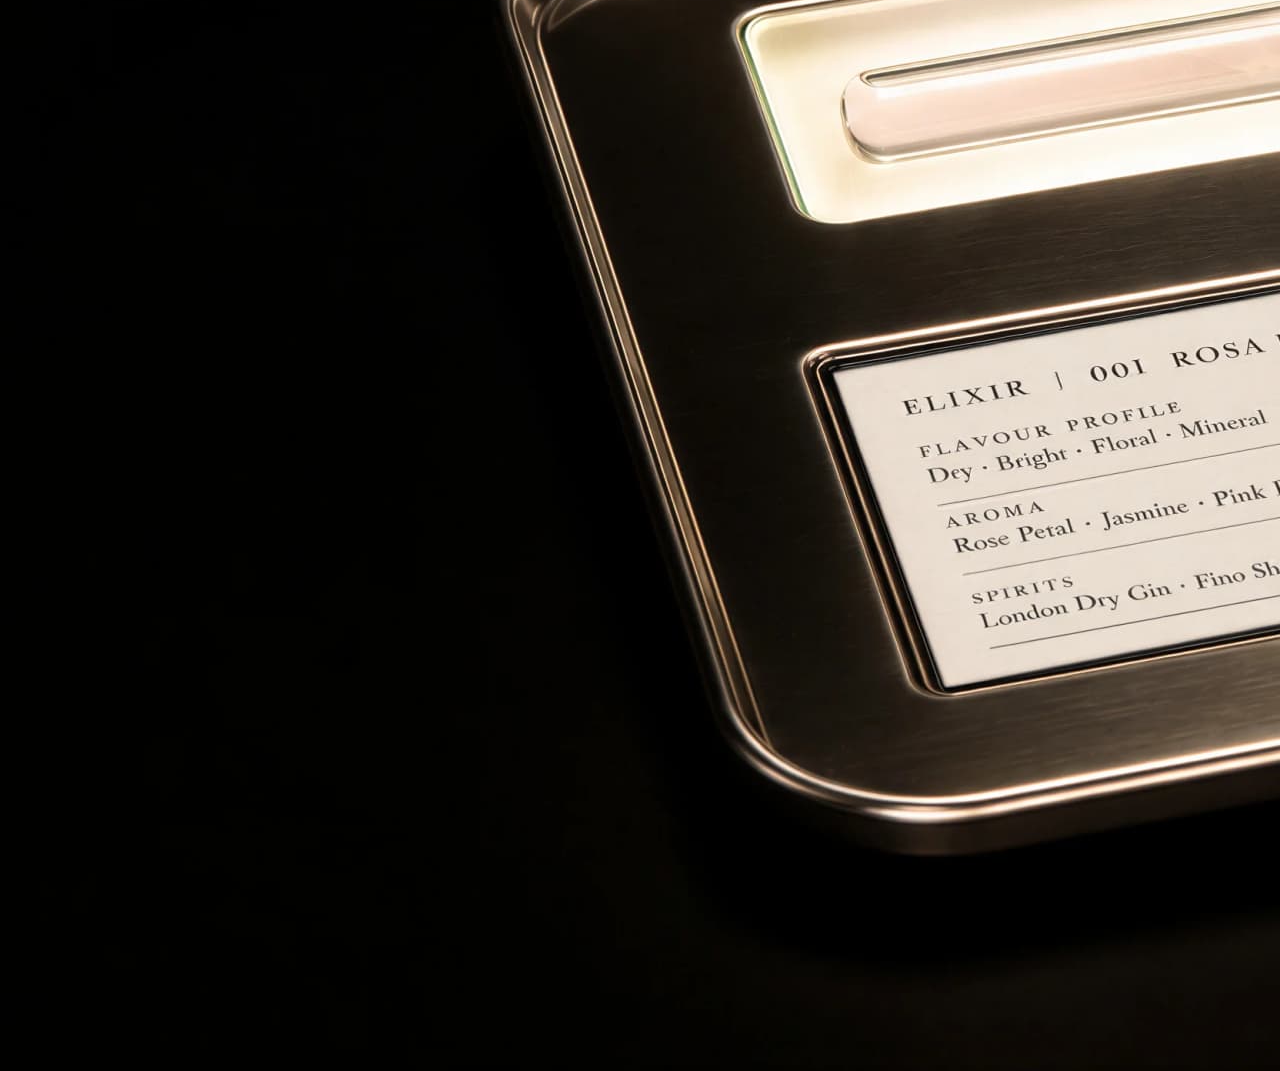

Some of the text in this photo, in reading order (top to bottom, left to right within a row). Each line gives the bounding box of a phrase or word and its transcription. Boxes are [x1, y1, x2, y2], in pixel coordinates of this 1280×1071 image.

[901, 380, 1030, 416] ELIXIR
[1089, 358, 1147, 382] 001
[1169, 337, 1267, 368] ROSA
[917, 400, 1183, 459] FLAVOUR PROFILE
[995, 447, 1068, 472] Bright
[1090, 428, 1158, 454] Floral
[1178, 409, 1269, 439] Mineral
[946, 501, 1046, 529] AROMA
[951, 535, 1010, 554] Rose
[1015, 517, 1076, 544] Petal
[1101, 502, 1190, 532] Jasmine
[1211, 484, 1268, 507] Pink
[971, 576, 1075, 605] SPIRITS
[978, 603, 1070, 629] London
[1073, 593, 1120, 612] Dry
[1127, 583, 1173, 602] Gin
[1193, 571, 1246, 590] Fino
